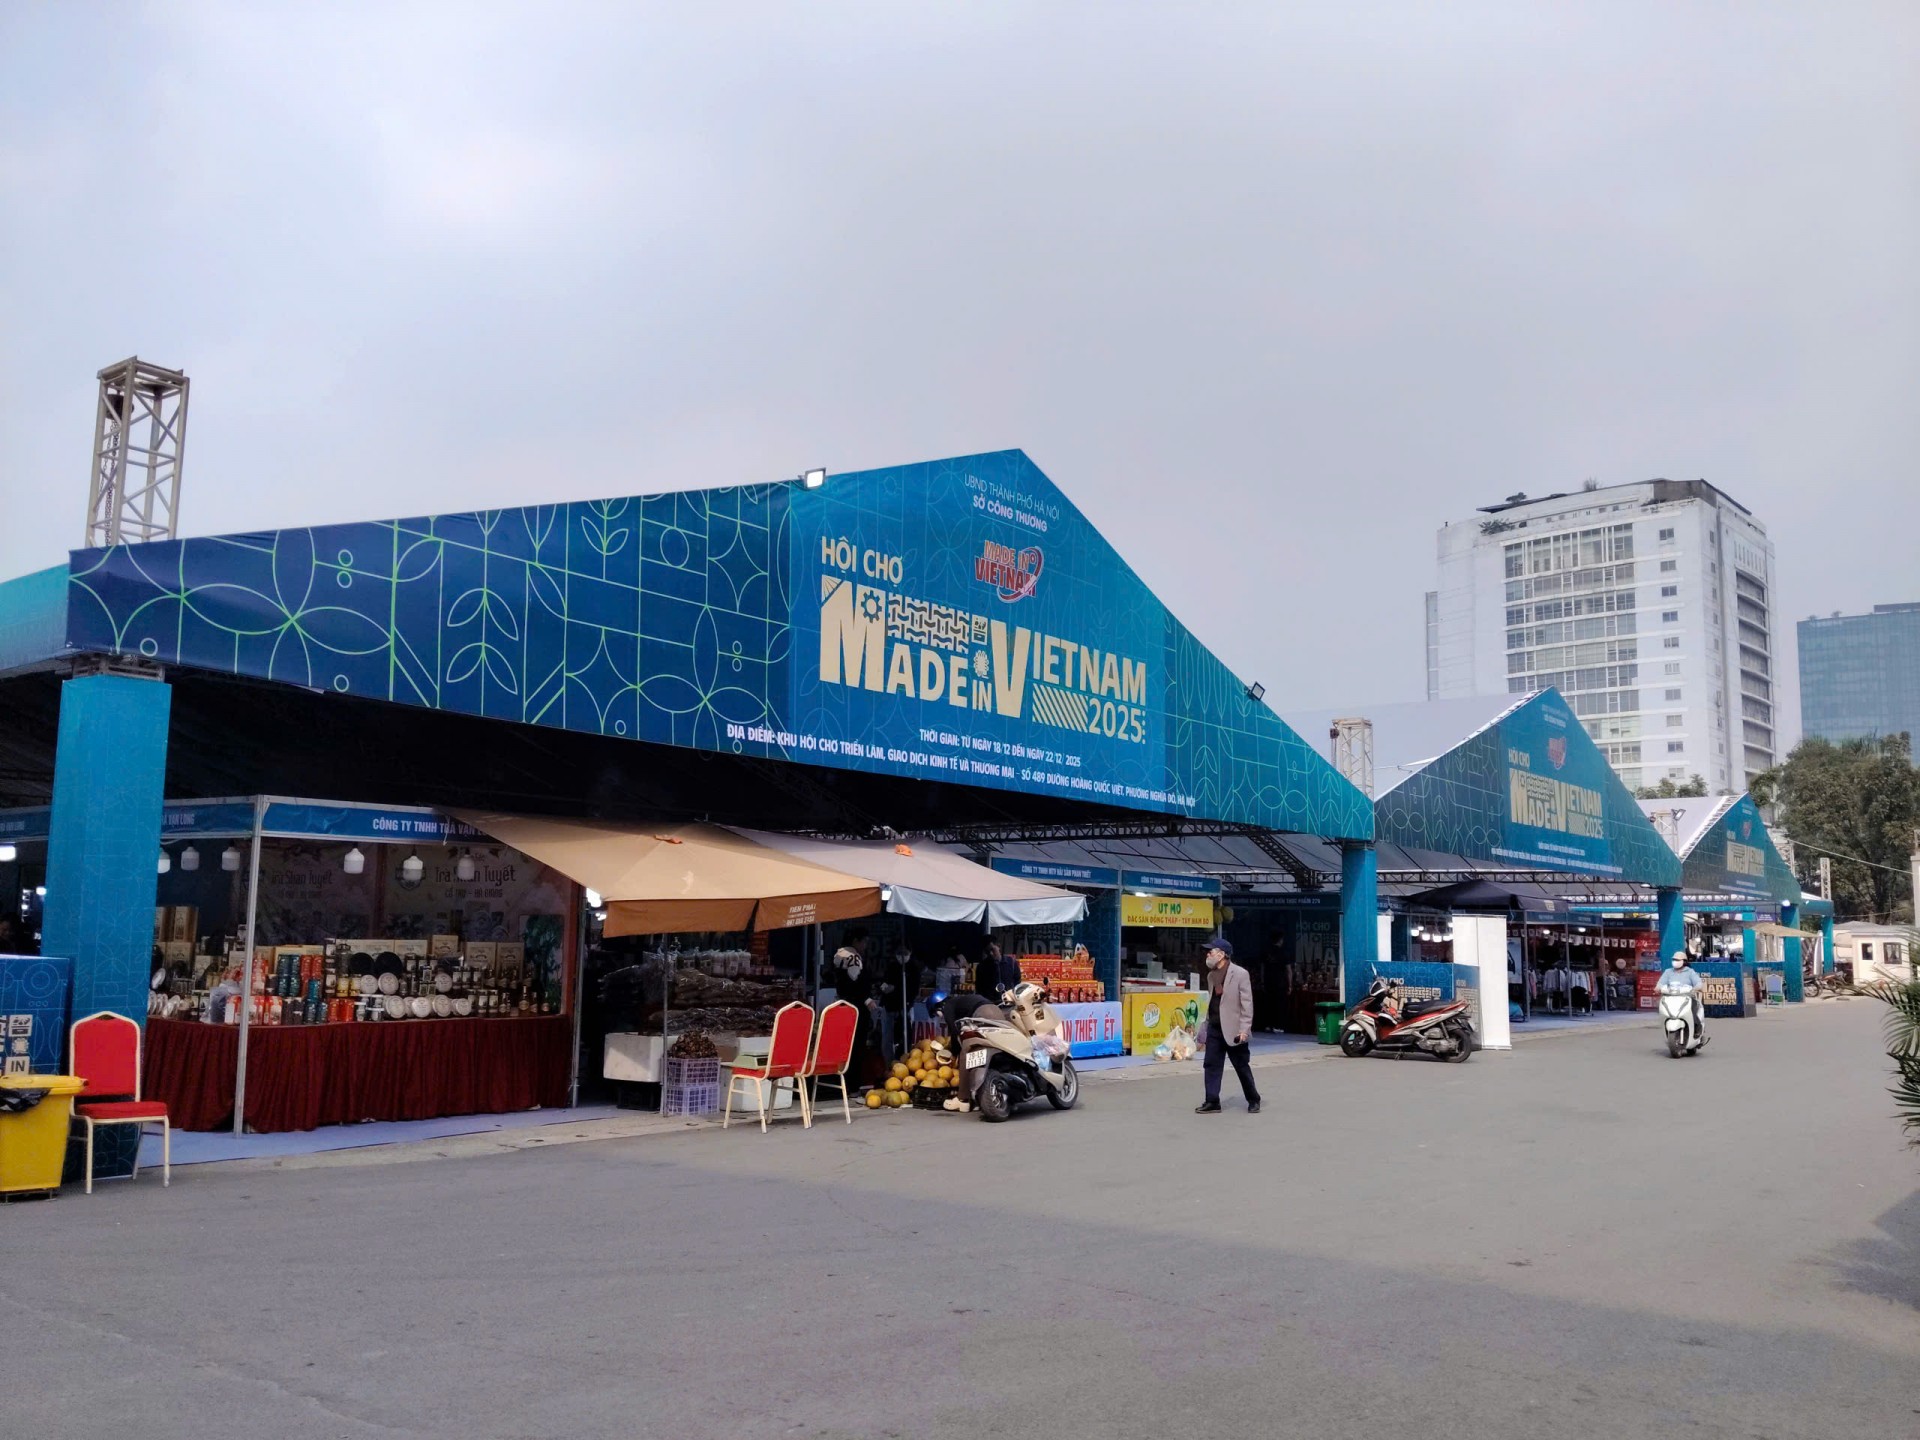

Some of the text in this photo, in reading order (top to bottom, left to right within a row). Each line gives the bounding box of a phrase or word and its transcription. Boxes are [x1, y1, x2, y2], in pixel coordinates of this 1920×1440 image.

[964, 473, 1060, 521] UBND THÀNH PHỐ HÀ NỘI
[973, 493, 1048, 532] SỞ CÔNG THƯƠNG
[821, 536, 904, 588] HỘI CHỢ
[984, 540, 1030, 571] MADE IN
[975, 555, 1037, 598] VIETNAM
[819, 574, 1146, 719] MADE IN VIETNAM
[1089, 697, 1143, 744] 2025
[919, 728, 938, 743] THỜI
[939, 732, 960, 747] GIAN:
[961, 735, 971, 748] TỪ
[972, 738, 992, 752] NGÀY
[1012, 742, 1025, 757] ĐẾN
[1026, 747, 1044, 760] NGÀY
[727, 723, 745, 740] ĐỊA
[747, 723, 776, 744] ĐIỂM:
[777, 732, 798, 747] KHU
[799, 734, 816, 751] HỘI
[818, 738, 838, 755] CHỢ
[839, 738, 864, 757] TRIỂN
[887, 748, 907, 763] GIAO
[909, 752, 928, 767] DỊCH
[929, 755, 947, 769] KINH
[949, 755, 959, 770] TẾ
[960, 757, 969, 772] VÀ
[971, 761, 1000, 777] THƯƠNG
[1001, 765, 1015, 779] MẠI
[1021, 766, 1031, 781] SỐ
[1032, 770, 1046, 783] 489
[1047, 772, 1069, 787] ĐƯỜNG
[1070, 776, 1093, 791] HOÀNG
[1093, 780, 1111, 794] QUỐC
[1125, 786, 1149, 800] PHƯỜNG
[1150, 789, 1167, 803] NGHĨA
[1177, 794, 1185, 806] HÀ
[1186, 796, 1196, 808] NỘI
[1509, 767, 1551, 830] MADE
[372, 816, 399, 832] CÔNG
[401, 820, 411, 832] TY
[414, 821, 437, 833] TNHH
[435, 866, 451, 883] Trà
[483, 864, 516, 887] Tuyết
[846, 954, 861, 968] 26
[1075, 1011, 1098, 1042] THIẾT
[10, 1060, 26, 1073] IN
